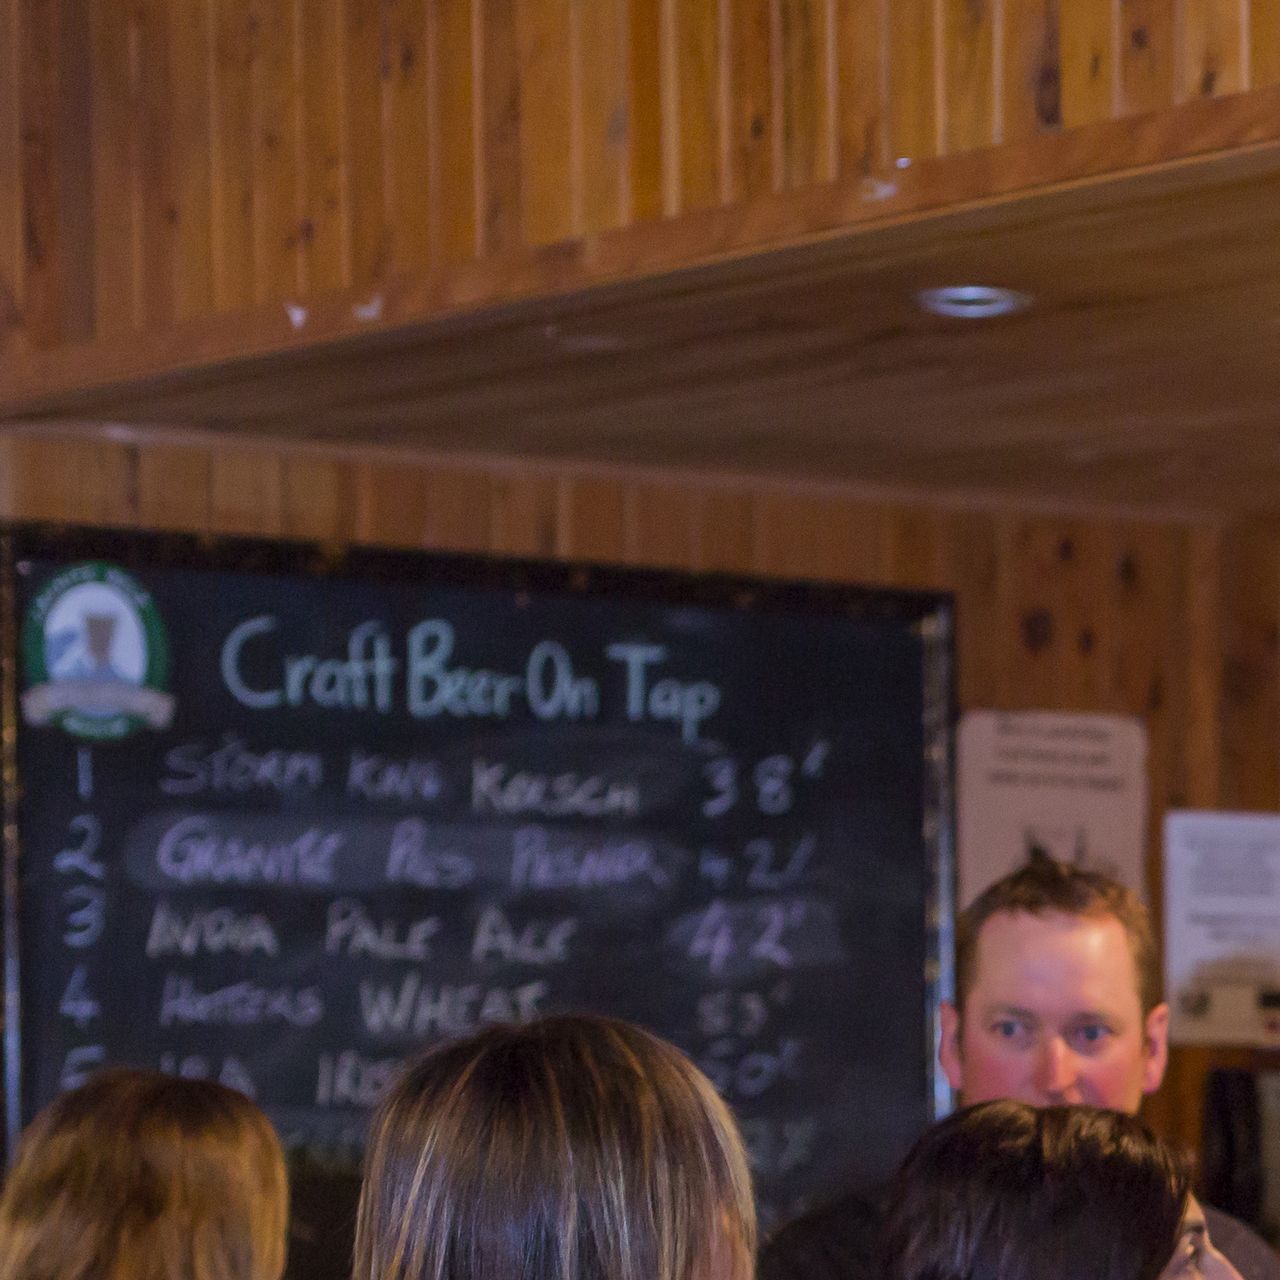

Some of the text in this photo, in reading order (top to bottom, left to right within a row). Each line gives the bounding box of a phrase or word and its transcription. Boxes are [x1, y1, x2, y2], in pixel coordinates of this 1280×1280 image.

[219, 614, 721, 746] Craft Beer On Tap
